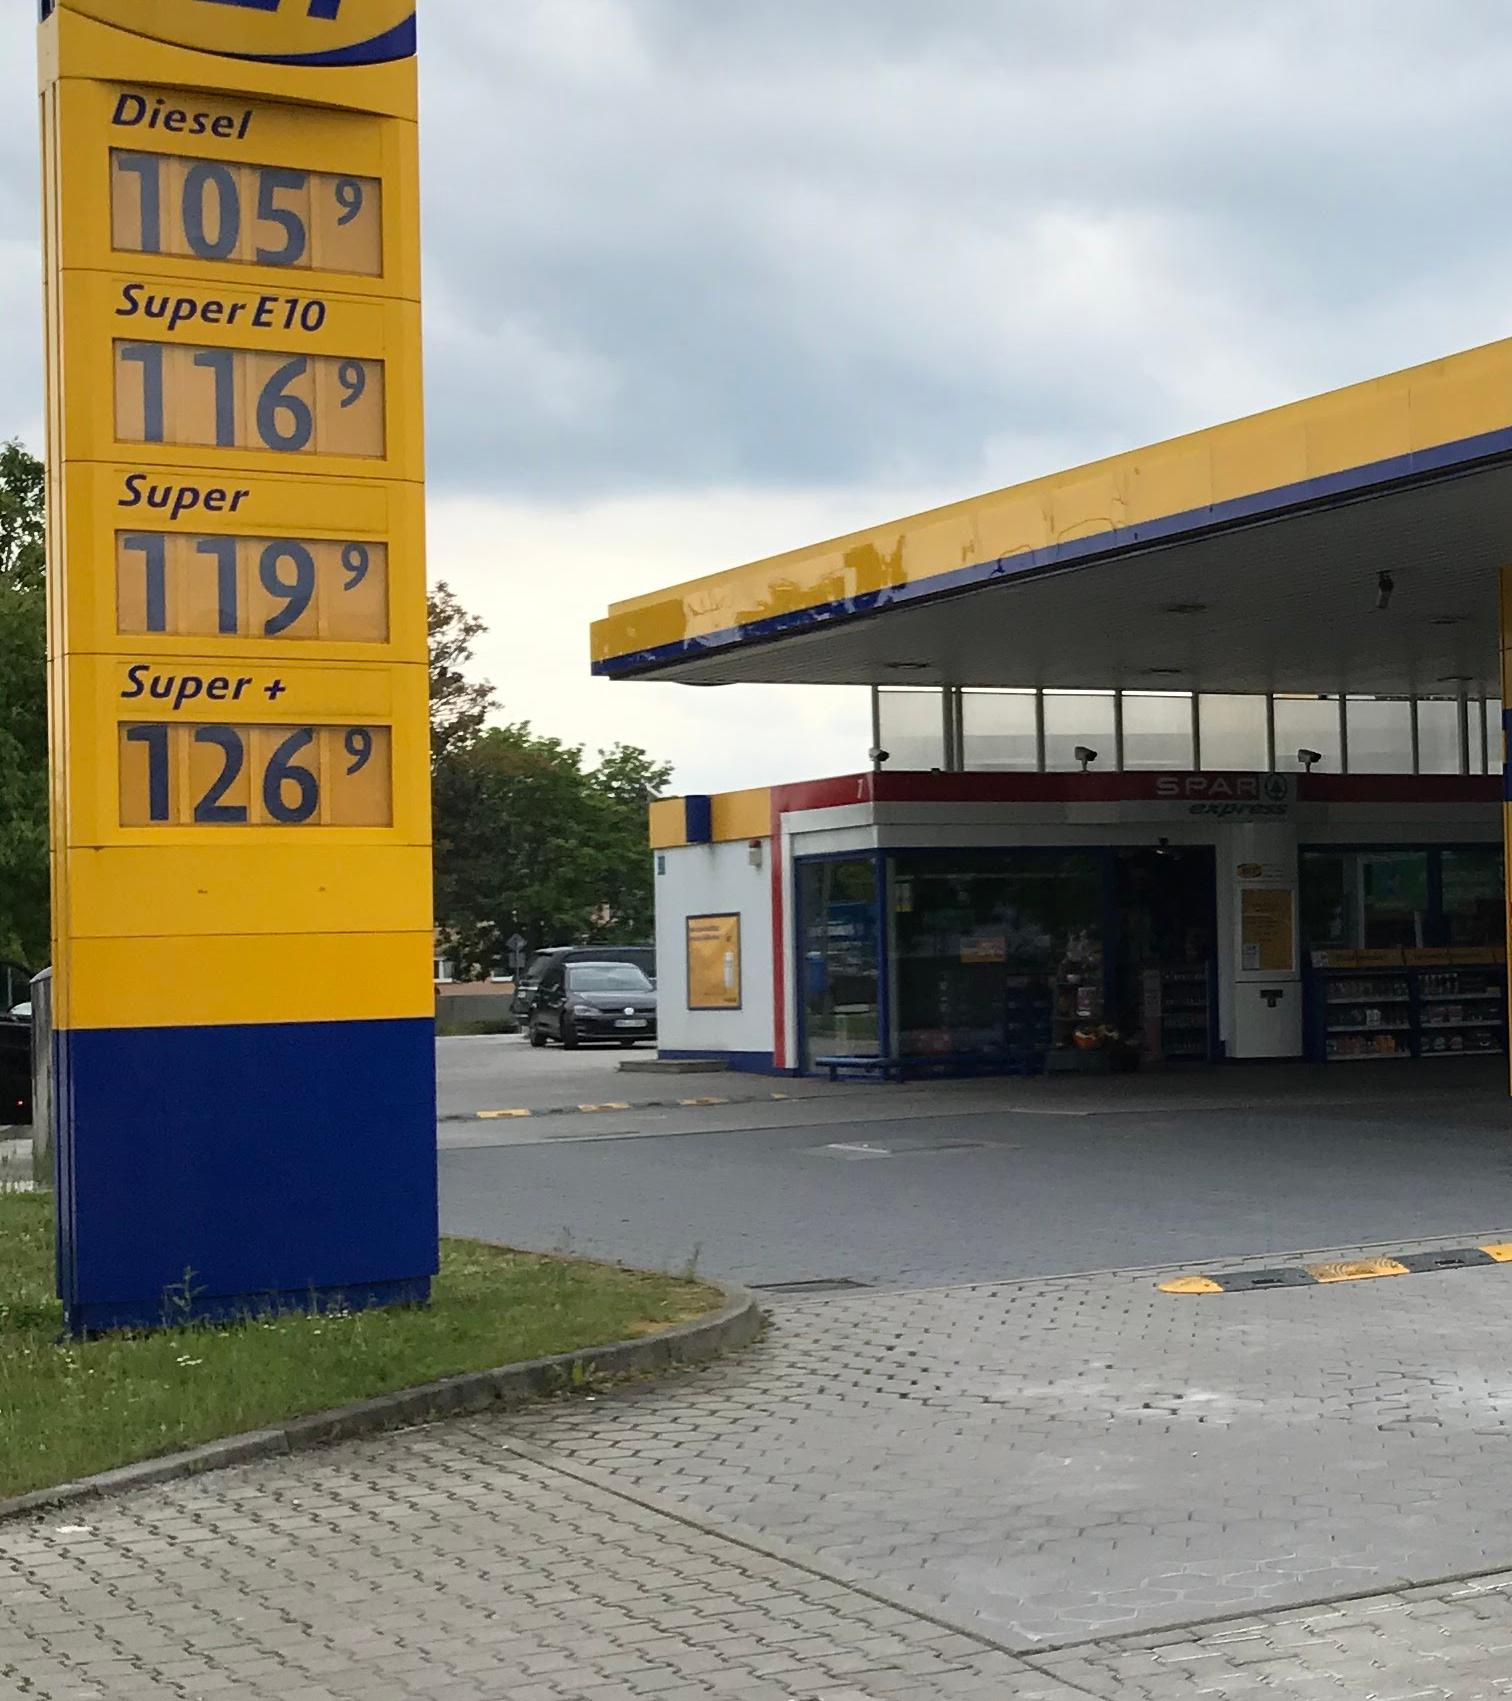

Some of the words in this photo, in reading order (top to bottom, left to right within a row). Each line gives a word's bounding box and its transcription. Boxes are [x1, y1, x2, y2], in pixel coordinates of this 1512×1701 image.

[111, 92, 254, 140] Diesel
[115, 283, 248, 331] Super
[251, 296, 326, 332] E10
[118, 473, 249, 520] Super
[121, 664, 253, 710] Super
[1156, 776, 1257, 796] SPAR
[1190, 803, 1288, 817] express
